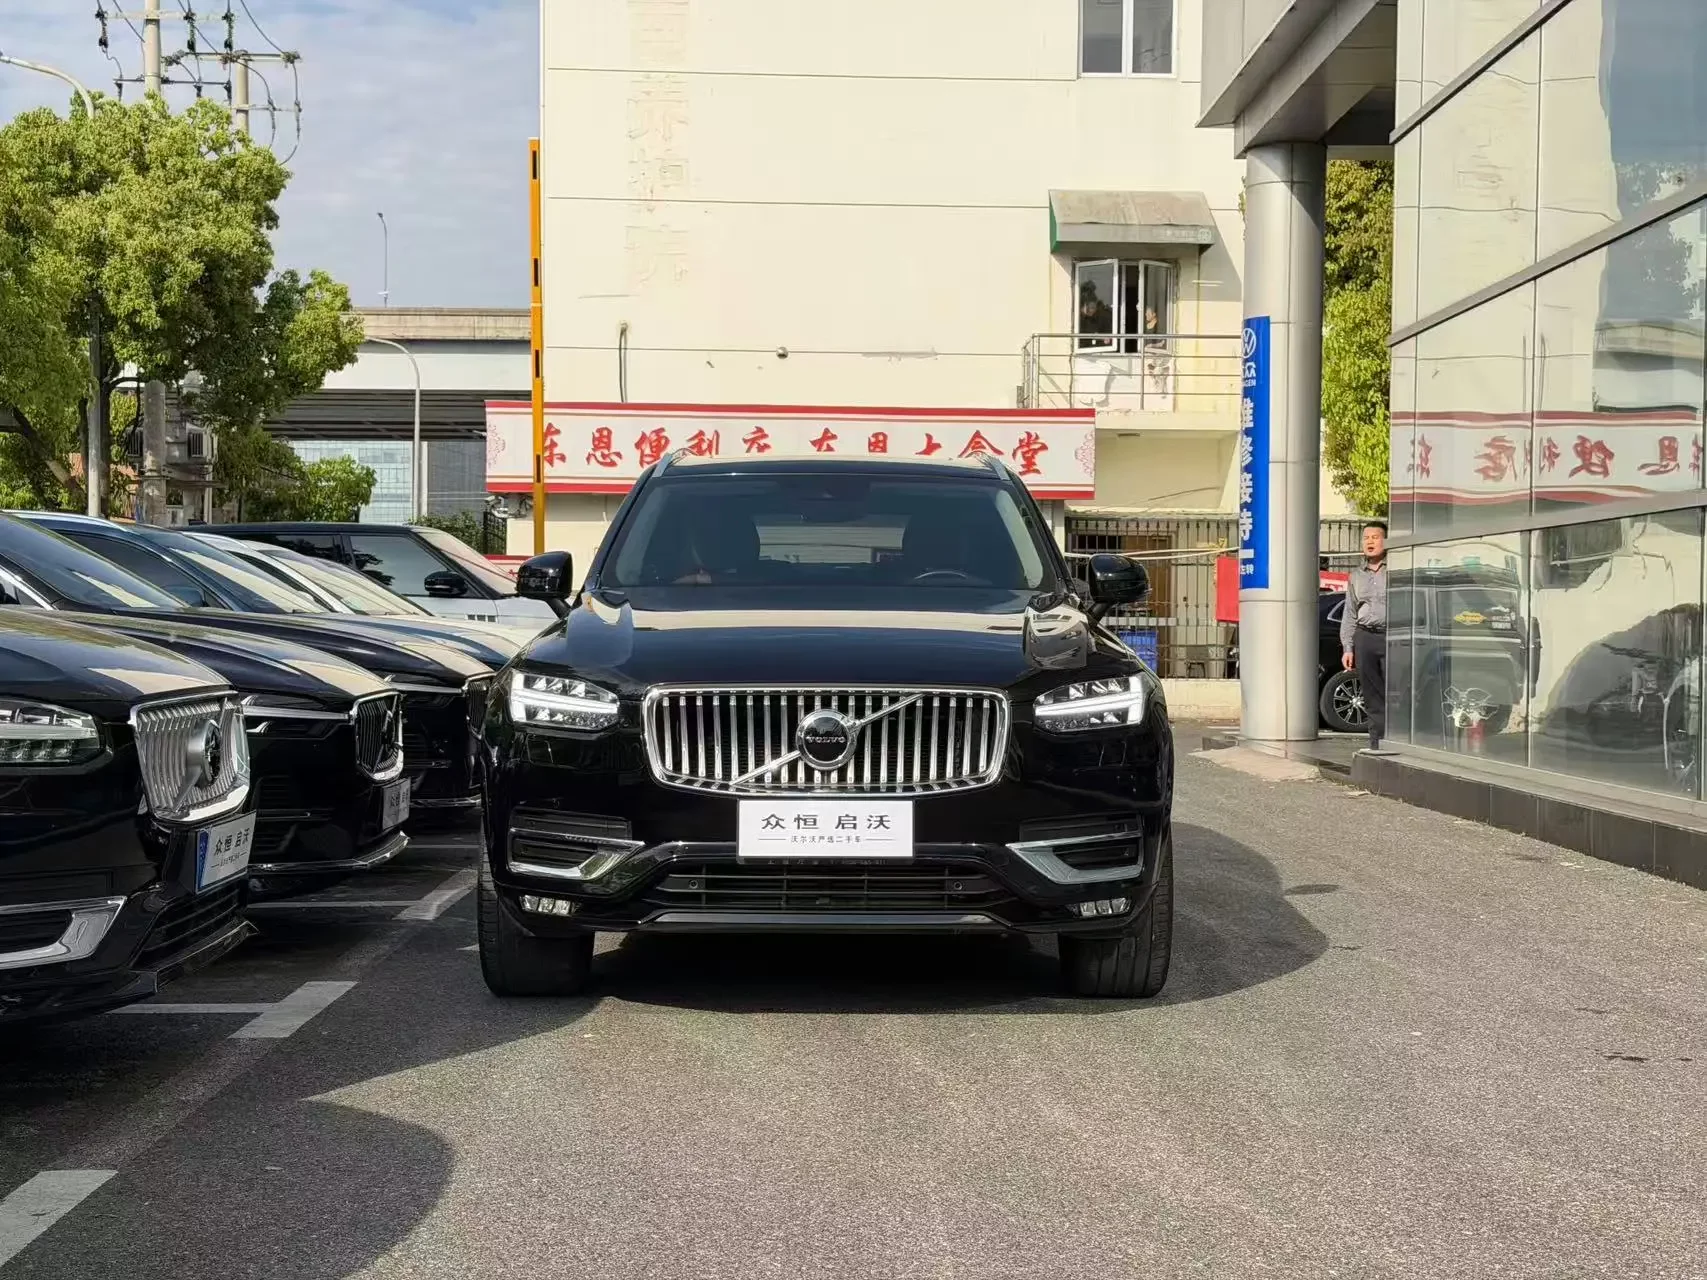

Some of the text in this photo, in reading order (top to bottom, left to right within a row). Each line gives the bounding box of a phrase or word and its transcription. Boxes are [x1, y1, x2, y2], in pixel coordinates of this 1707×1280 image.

[805, 735, 846, 743] VOLVO
[760, 813, 891, 830] 众恒 启沃
